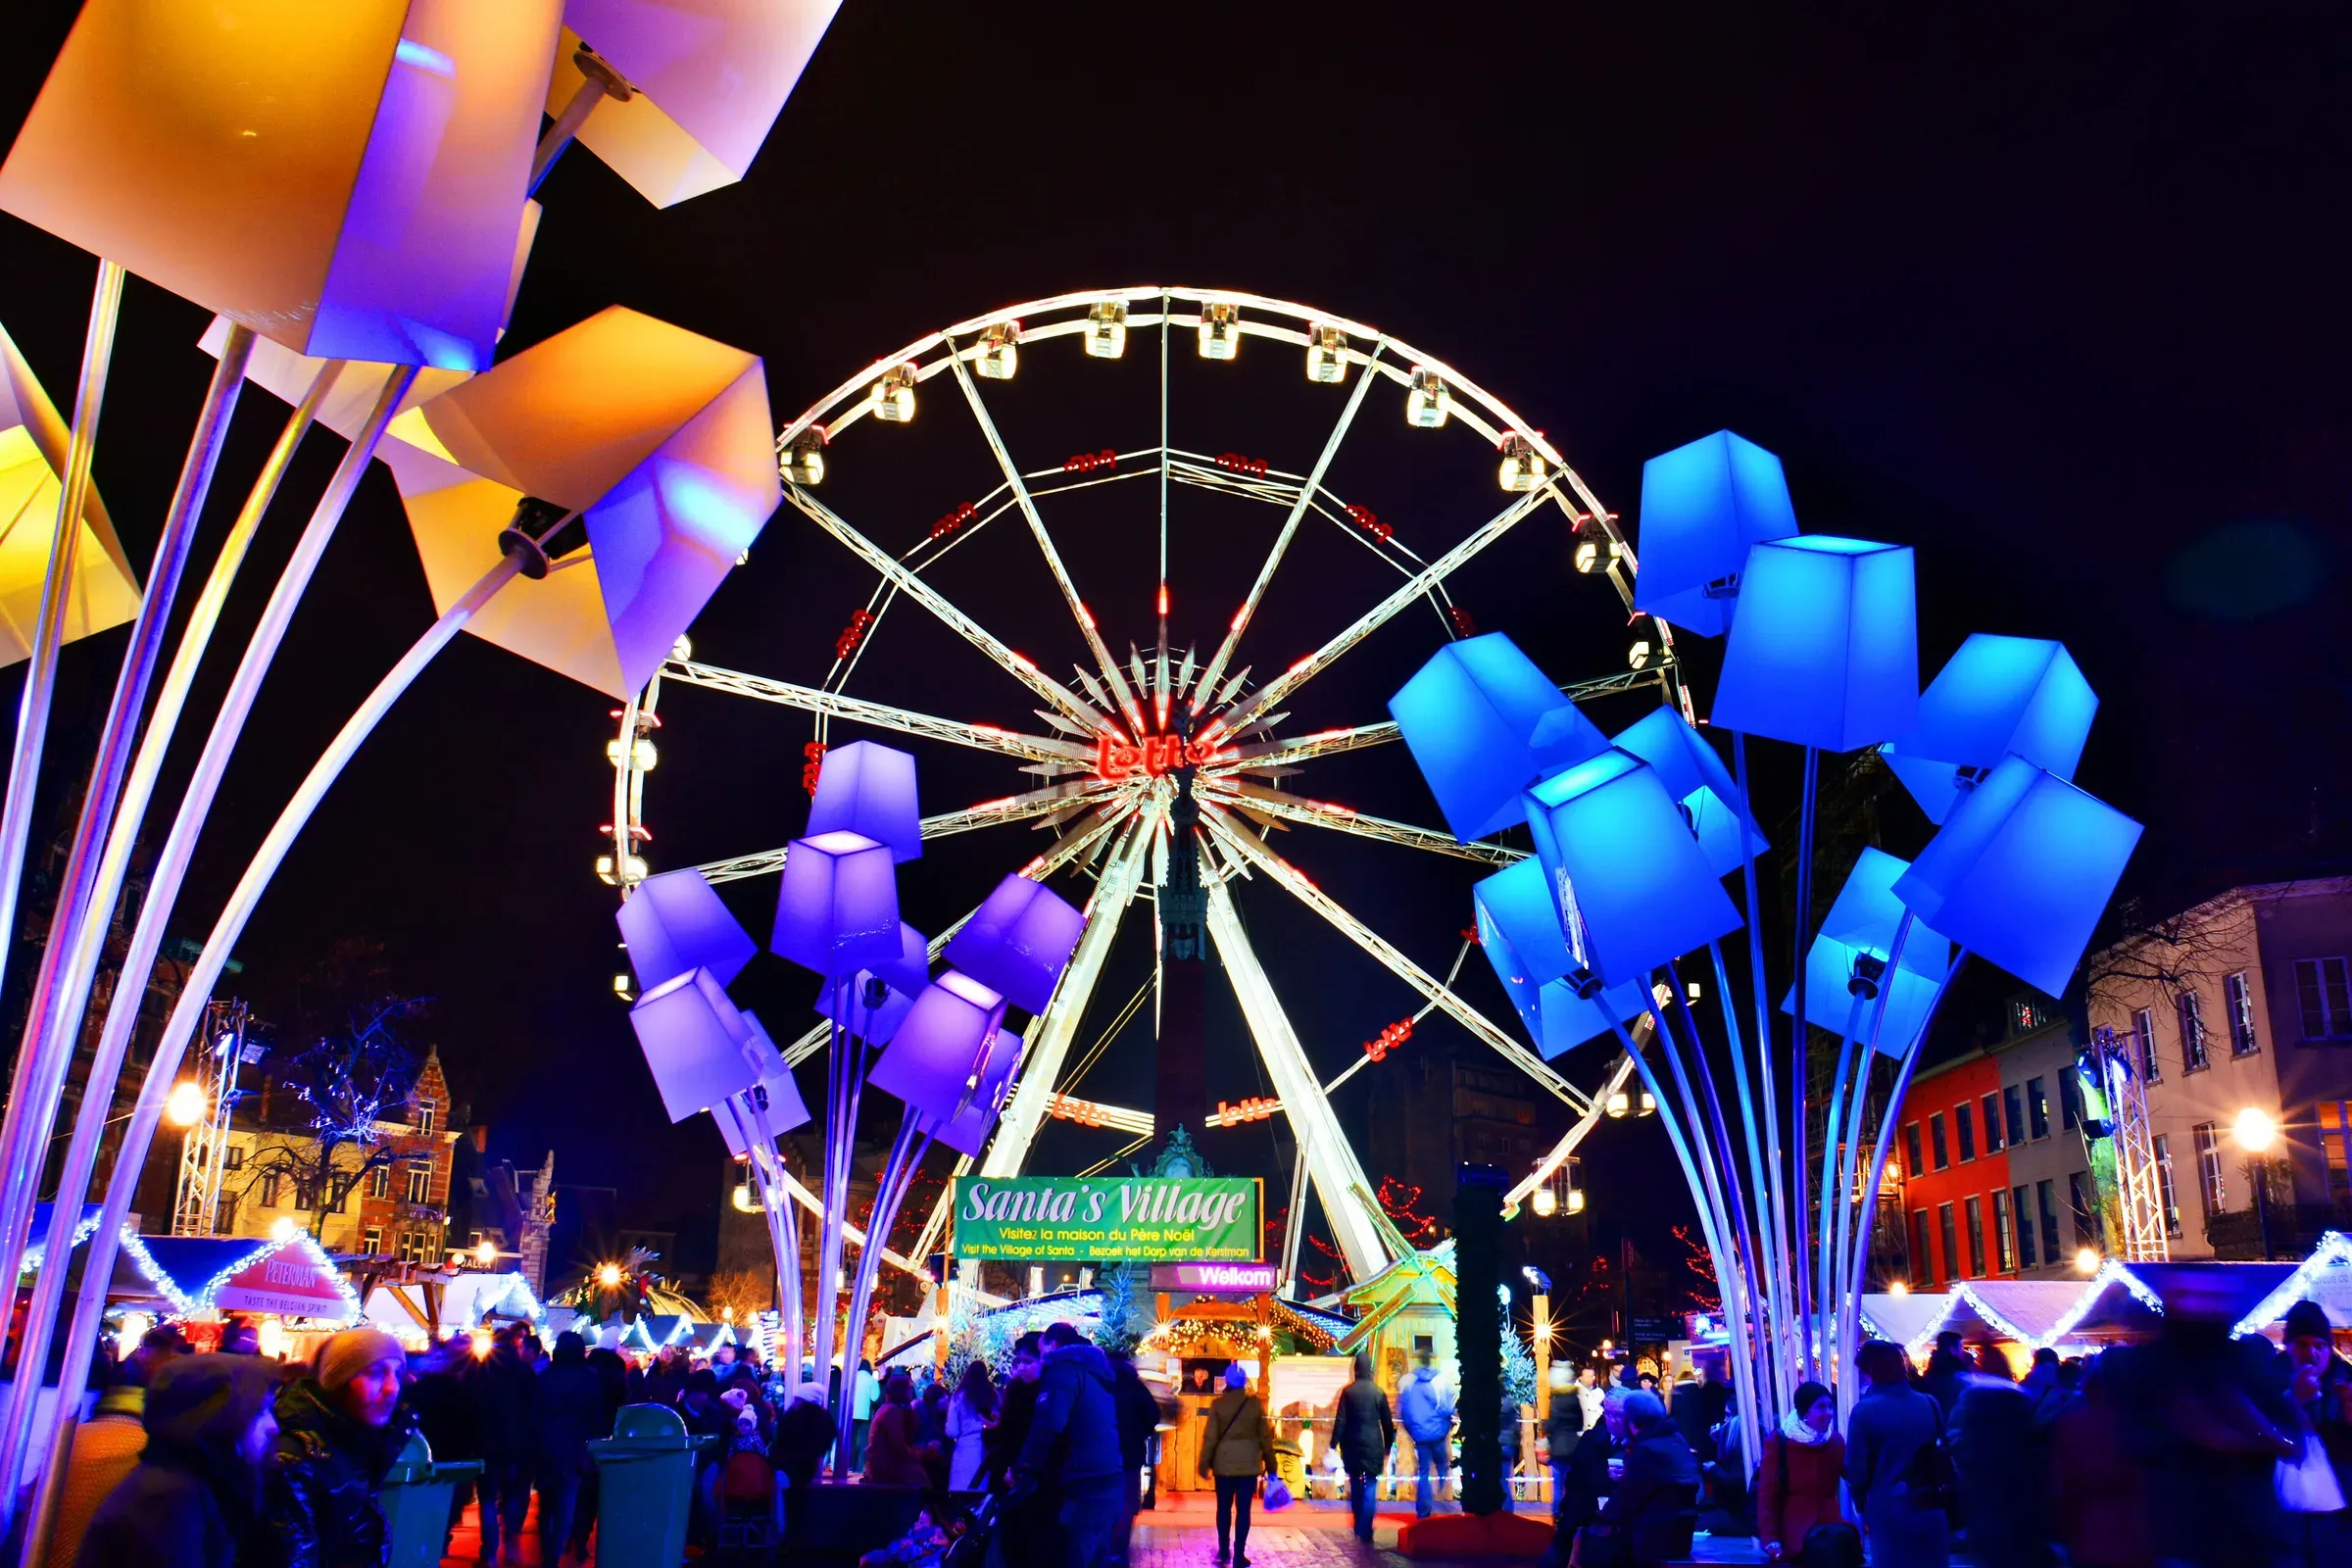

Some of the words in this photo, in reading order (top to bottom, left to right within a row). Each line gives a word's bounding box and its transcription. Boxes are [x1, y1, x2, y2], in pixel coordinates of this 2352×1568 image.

[1097, 734, 1217, 782] Lotto
[1217, 1097, 1277, 1127] Lotto
[963, 1183, 1107, 1223] Santa's
[1121, 1184, 1247, 1231] Village
[1000, 1227, 1038, 1240] Visitez
[1041, 1228, 1054, 1240] la
[1057, 1230, 1105, 1241] maison
[1108, 1229, 1127, 1241] du
[1131, 1228, 1160, 1242] Père
[1163, 1229, 1195, 1242] Noël
[962, 1244, 979, 1254] Visit
[982, 1244, 998, 1254] the
[1000, 1245, 1033, 1257] Village
[1035, 1245, 1046, 1255] of
[1047, 1246, 1075, 1255] Santa
[1089, 1246, 1123, 1256] Bezoek
[1125, 1247, 1142, 1256] het
[1143, 1247, 1167, 1257] Dorp
[1169, 1249, 1188, 1257] van
[1190, 1247, 1203, 1256] de
[1205, 1247, 1250, 1257] Kerstman
[265, 1258, 318, 1288] PETERMAN
[1199, 1266, 1271, 1286] Welkom
[245, 1295, 264, 1307] TASTE
[266, 1298, 278, 1309] THE
[279, 1298, 306, 1311] BELGIAN
[307, 1302, 328, 1313] SPIRIT
